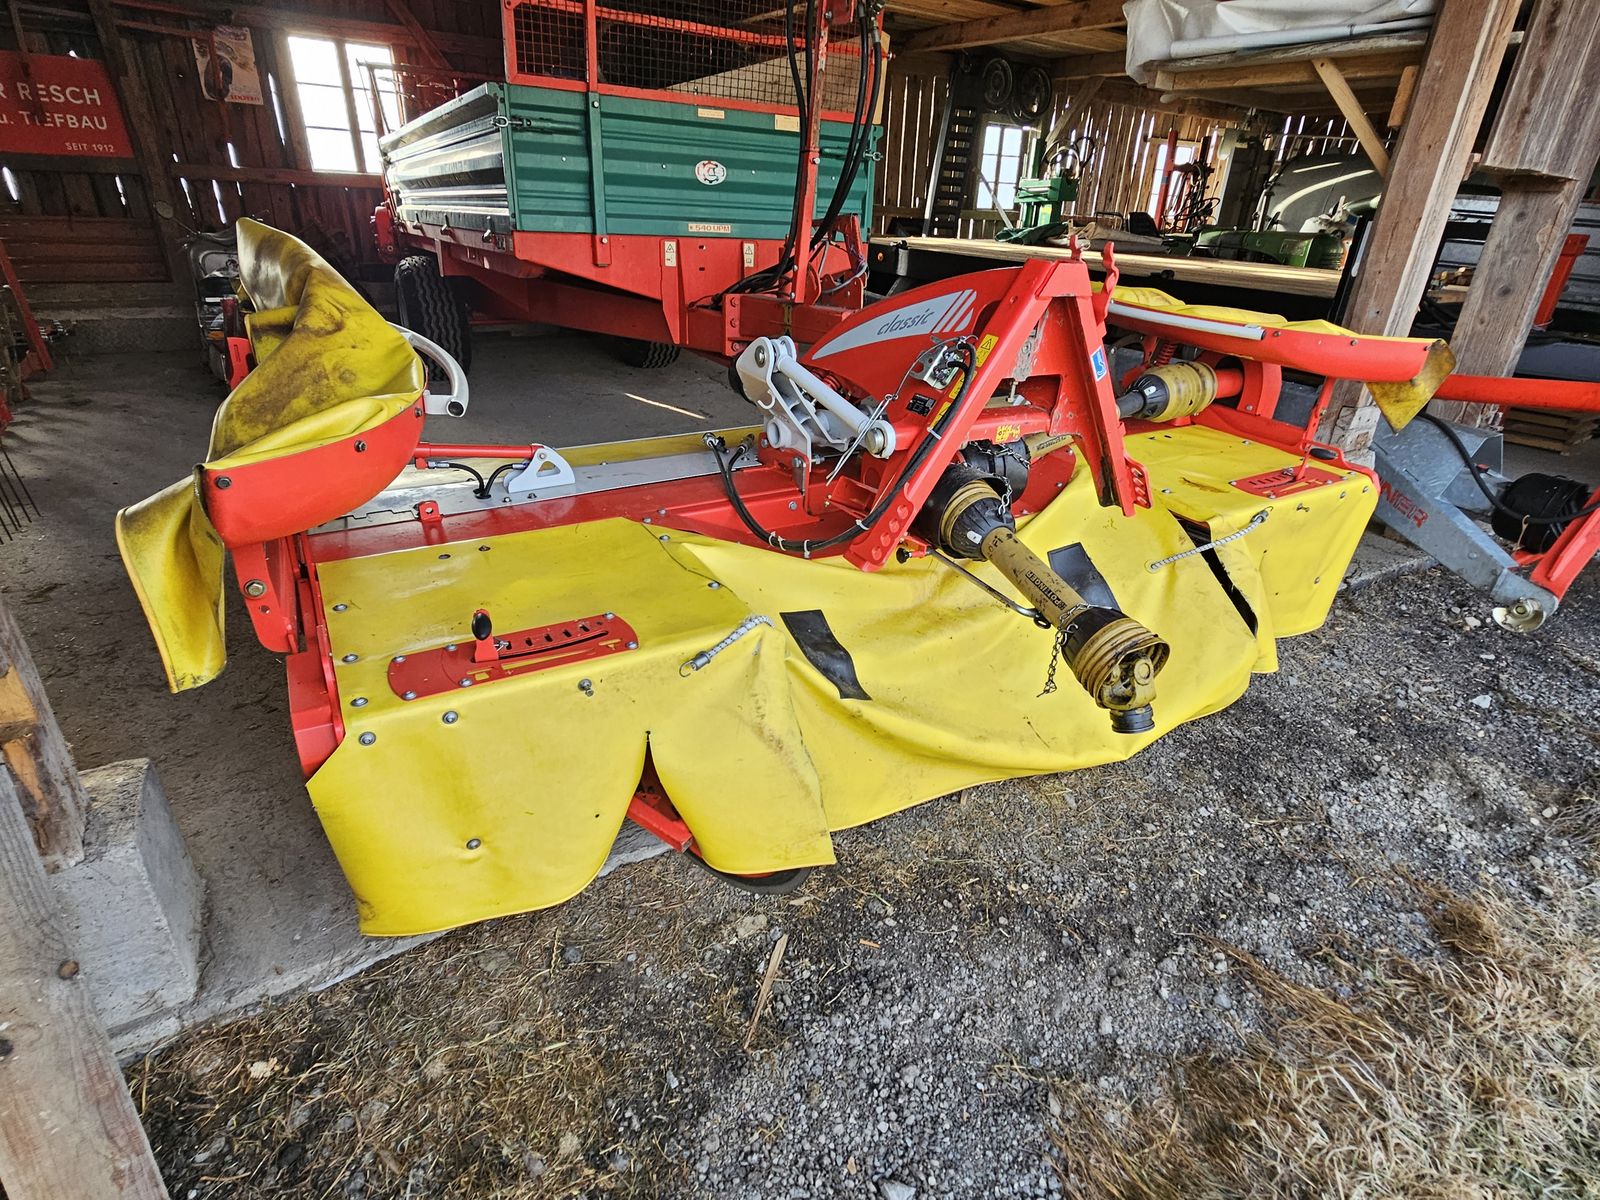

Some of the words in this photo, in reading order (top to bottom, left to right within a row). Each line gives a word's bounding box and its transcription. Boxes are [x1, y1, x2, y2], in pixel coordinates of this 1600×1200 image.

[17, 82, 101, 106] RESCH
[18, 110, 107, 130] TIEFBAU
[65, 142, 88, 151] SEIT
[92, 143, 115, 153] 1912
[712, 225, 730, 233] UPM
[876, 308, 935, 336] classic
